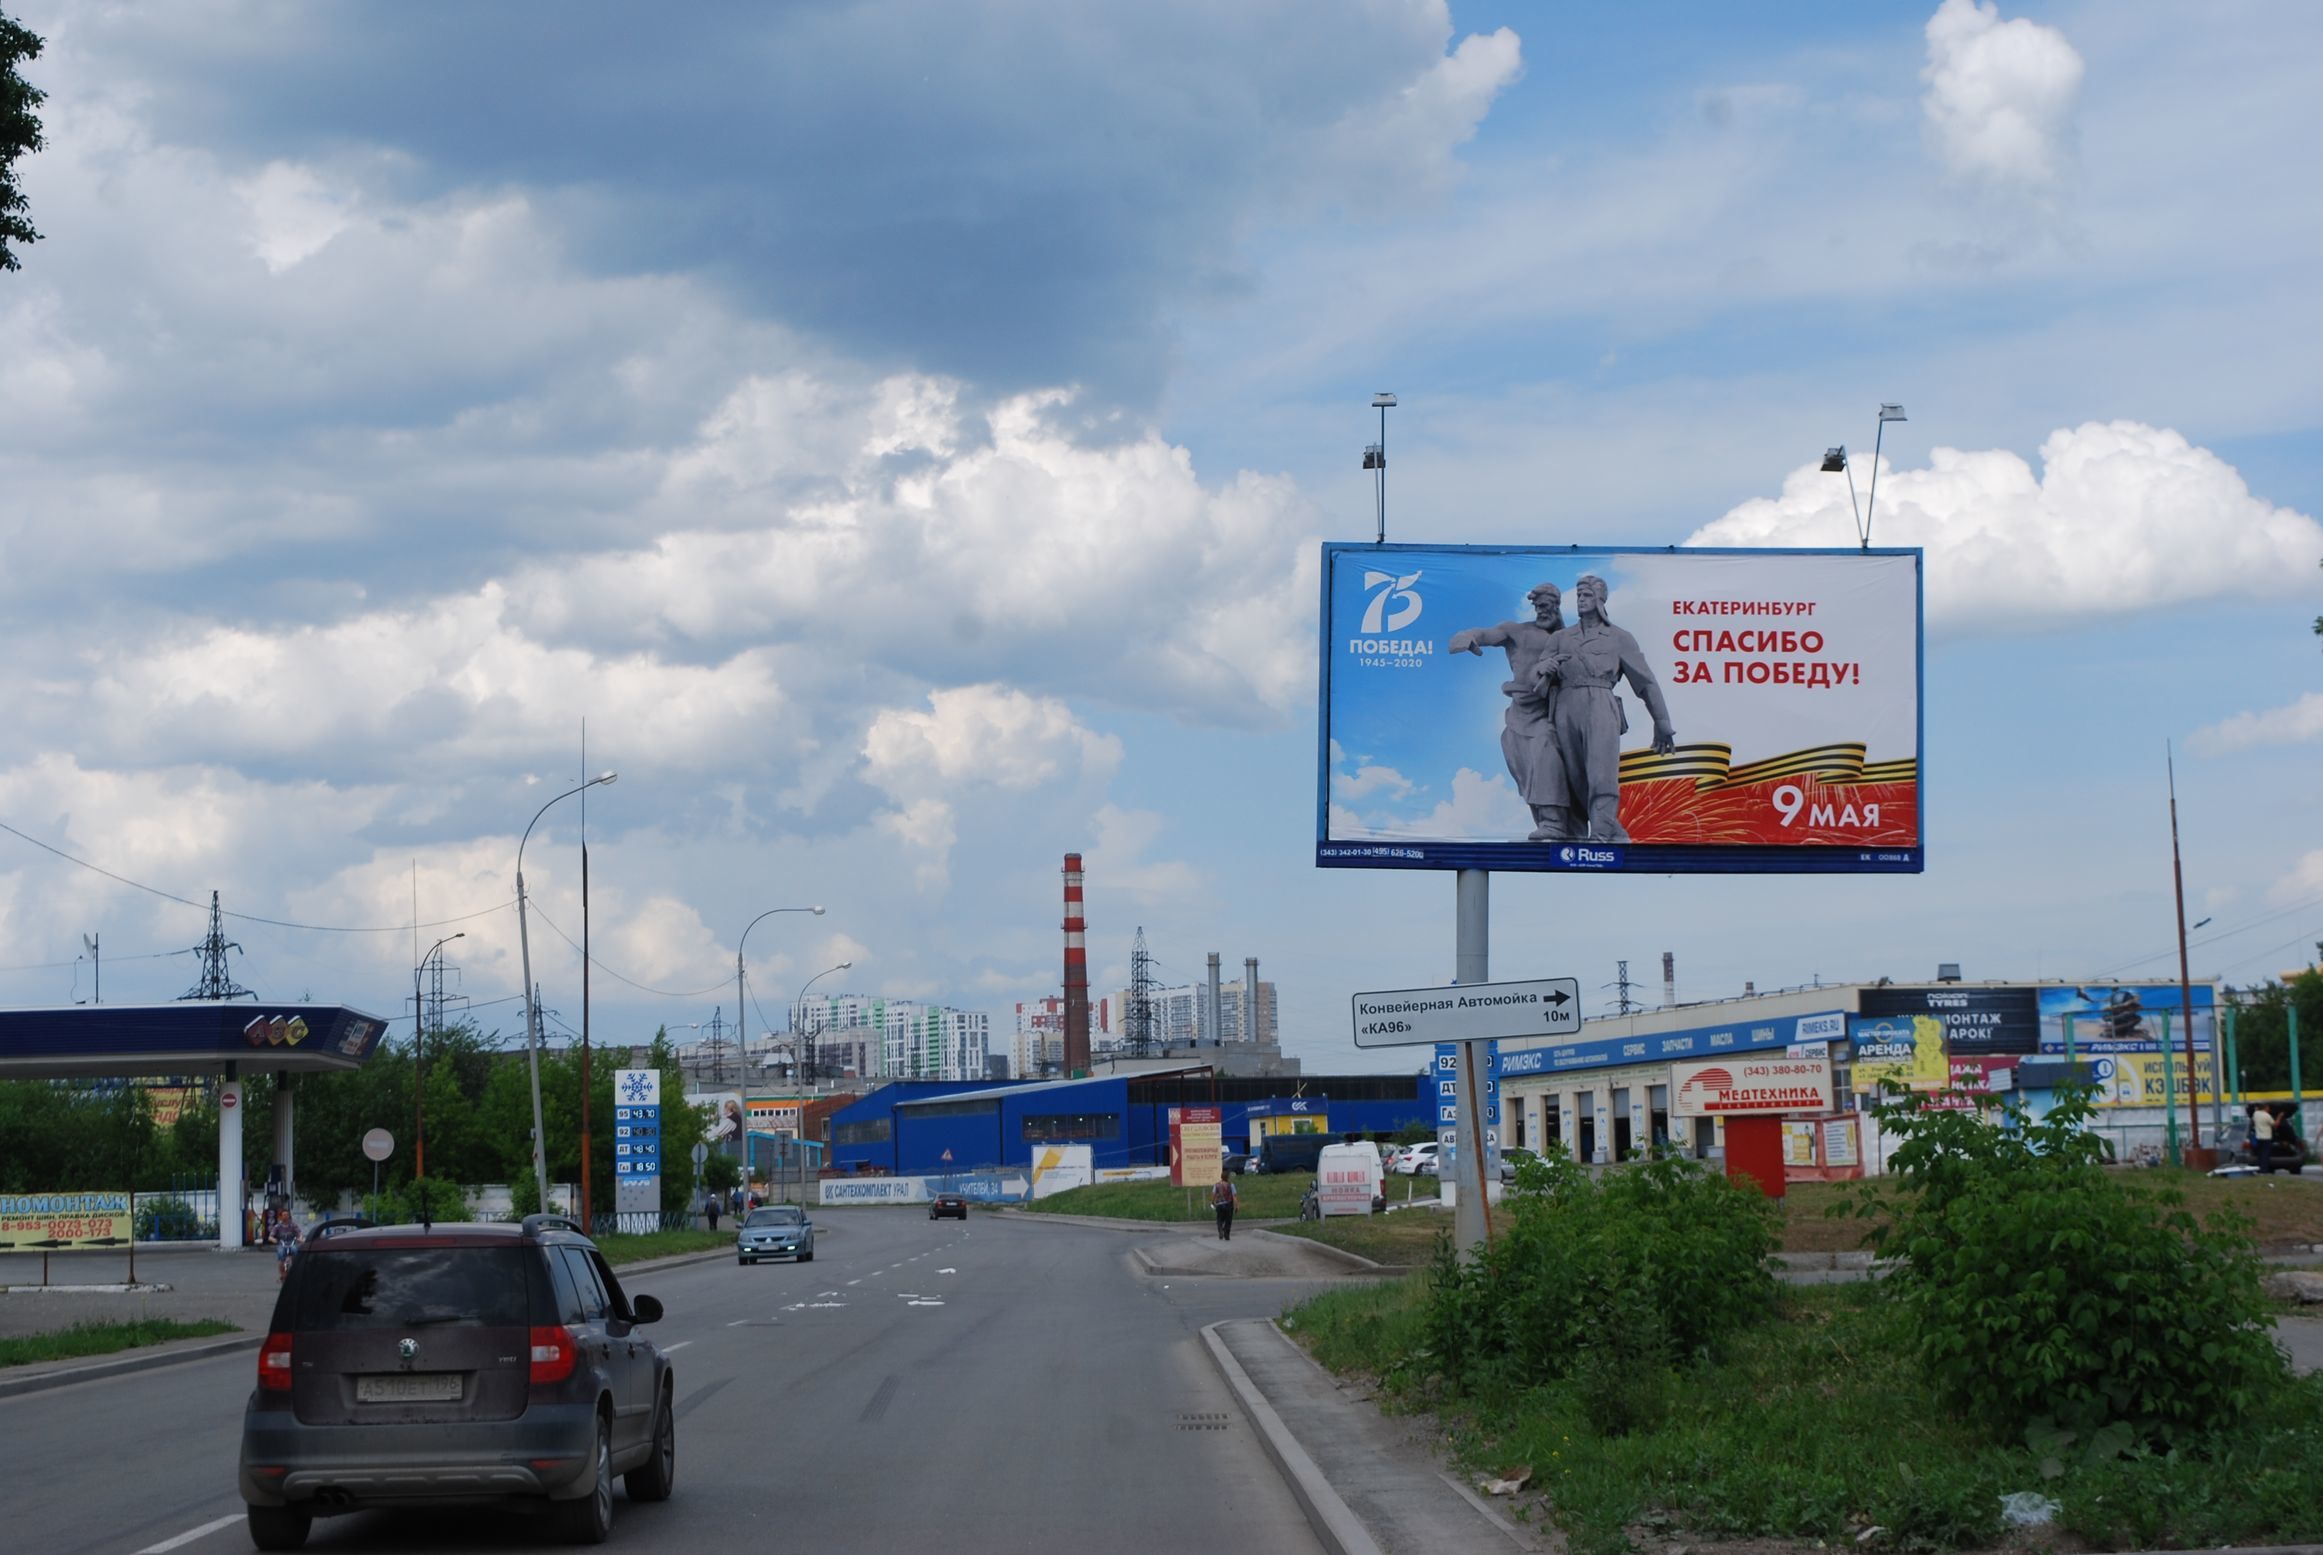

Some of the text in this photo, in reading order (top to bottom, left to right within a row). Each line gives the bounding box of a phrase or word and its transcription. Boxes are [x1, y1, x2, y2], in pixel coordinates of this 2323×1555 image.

[1361, 571, 1422, 633] 75
[1673, 601, 1816, 616] ЕКАТЕРИНБУРГ
[1350, 639, 1433, 657] ПОБЕДА!
[1673, 630, 1824, 653] СПАСИБО
[1673, 661, 1859, 689] ЗА ПОБЕДУ!
[1772, 784, 1879, 828] 9 МАЯ
[1578, 848, 1615, 862] Russ
[1360, 992, 1537, 1015] Конвейерная Автомойка
[1543, 1011, 1570, 1022] 10м
[1361, 1021, 1412, 1034] «КА96»
[1751, 1027, 1775, 1042] ШИНЫ
[1802, 1019, 1840, 1035] RIMEKS.RU
[1623, 1043, 1646, 1056] СЕРВИС
[1662, 1037, 1693, 1052] ЗАПЧАСТИ
[1859, 1043, 1911, 1057] АРЕНДА
[1440, 1057, 1456, 1069] 92
[1502, 1052, 1542, 1072] РИМЭКС
[1744, 1064, 1822, 1077] (343) 380-80-70
[1719, 1087, 1819, 1101] МЕДТЕХНИКА
[835, 1183, 892, 1198] САНТЕХКОМПЛЕКТ
[893, 1182, 909, 1197] УРАЛ
[0, 1193, 129, 1214] НОМОНТАЖ
[48, 1228, 111, 1239] 2000-173
